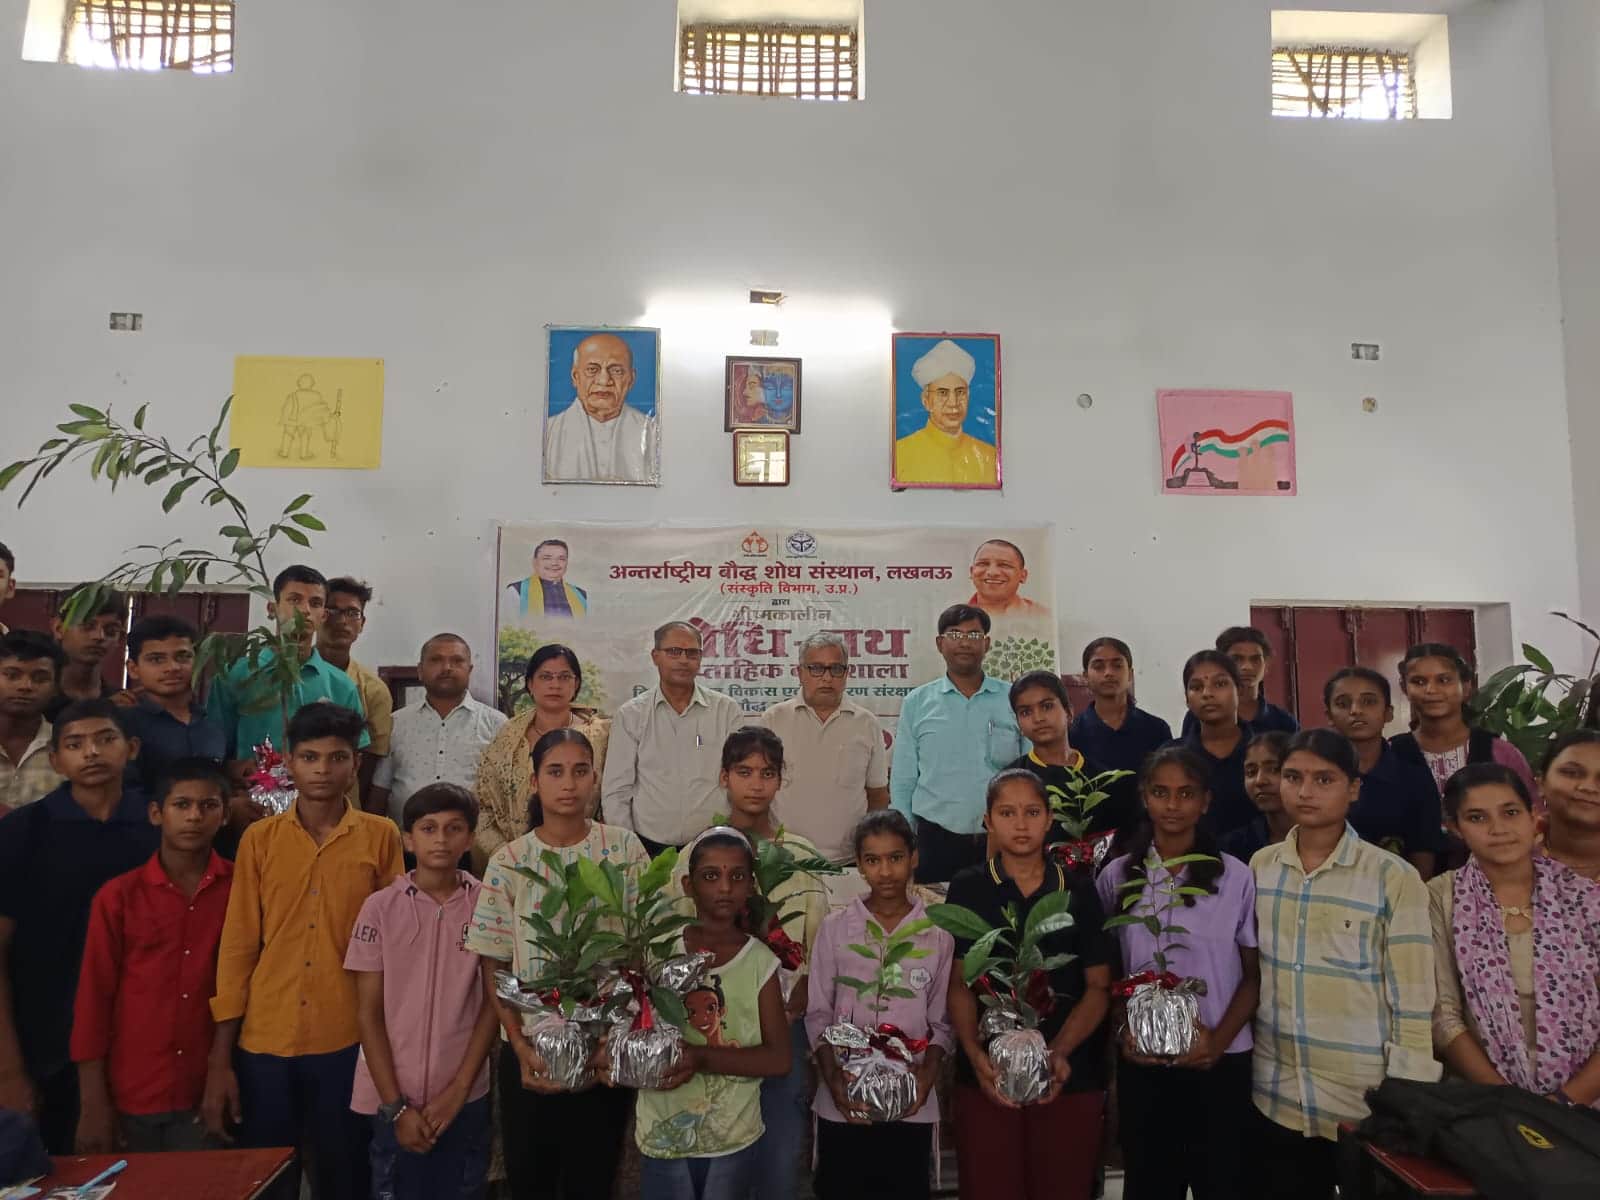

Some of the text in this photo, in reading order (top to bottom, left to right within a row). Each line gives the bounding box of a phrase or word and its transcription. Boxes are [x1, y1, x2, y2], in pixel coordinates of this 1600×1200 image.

[609, 560, 953, 583] अन्तर्राष्ट्रीय बौद्ध शोध संस्थान, लखनऊ
